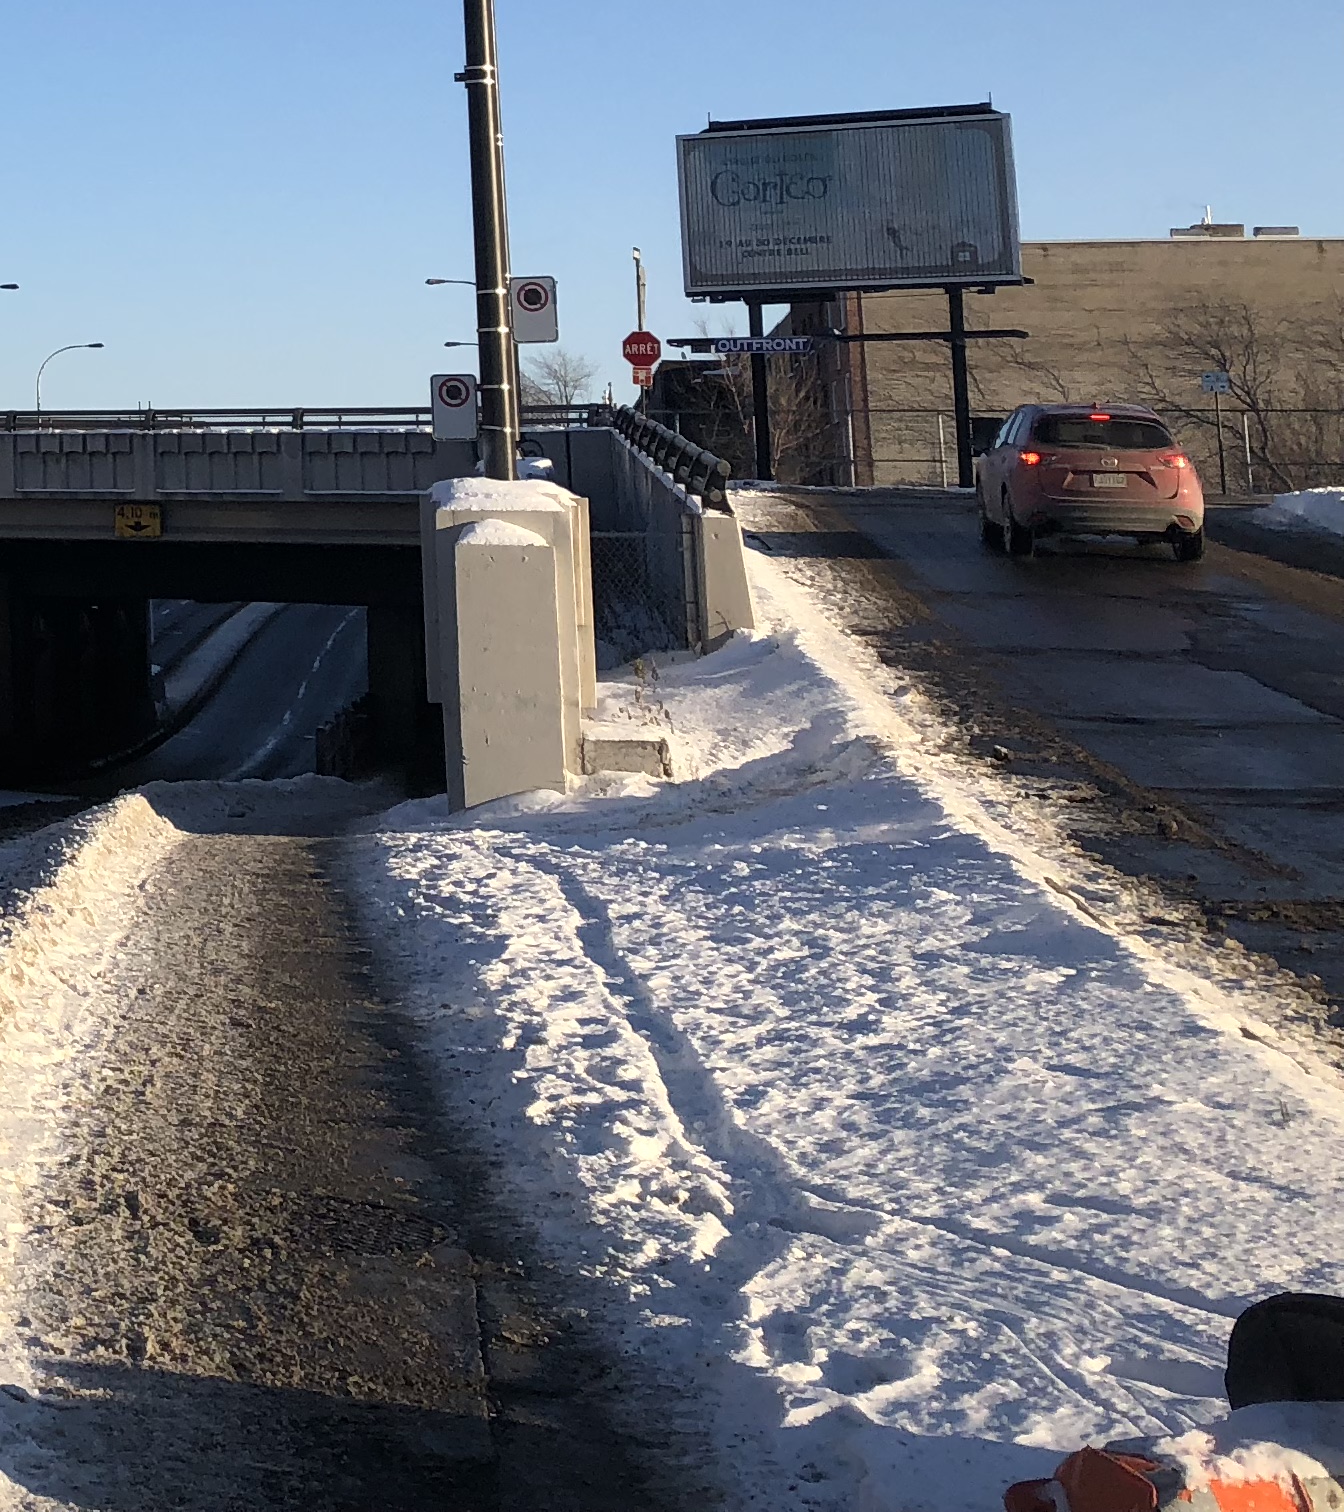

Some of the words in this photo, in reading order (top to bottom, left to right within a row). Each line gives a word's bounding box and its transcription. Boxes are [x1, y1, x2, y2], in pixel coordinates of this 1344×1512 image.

[738, 238, 752, 248] AU
[625, 342, 659, 355] ARRÊT
[717, 338, 808, 352] OUTFRONT
